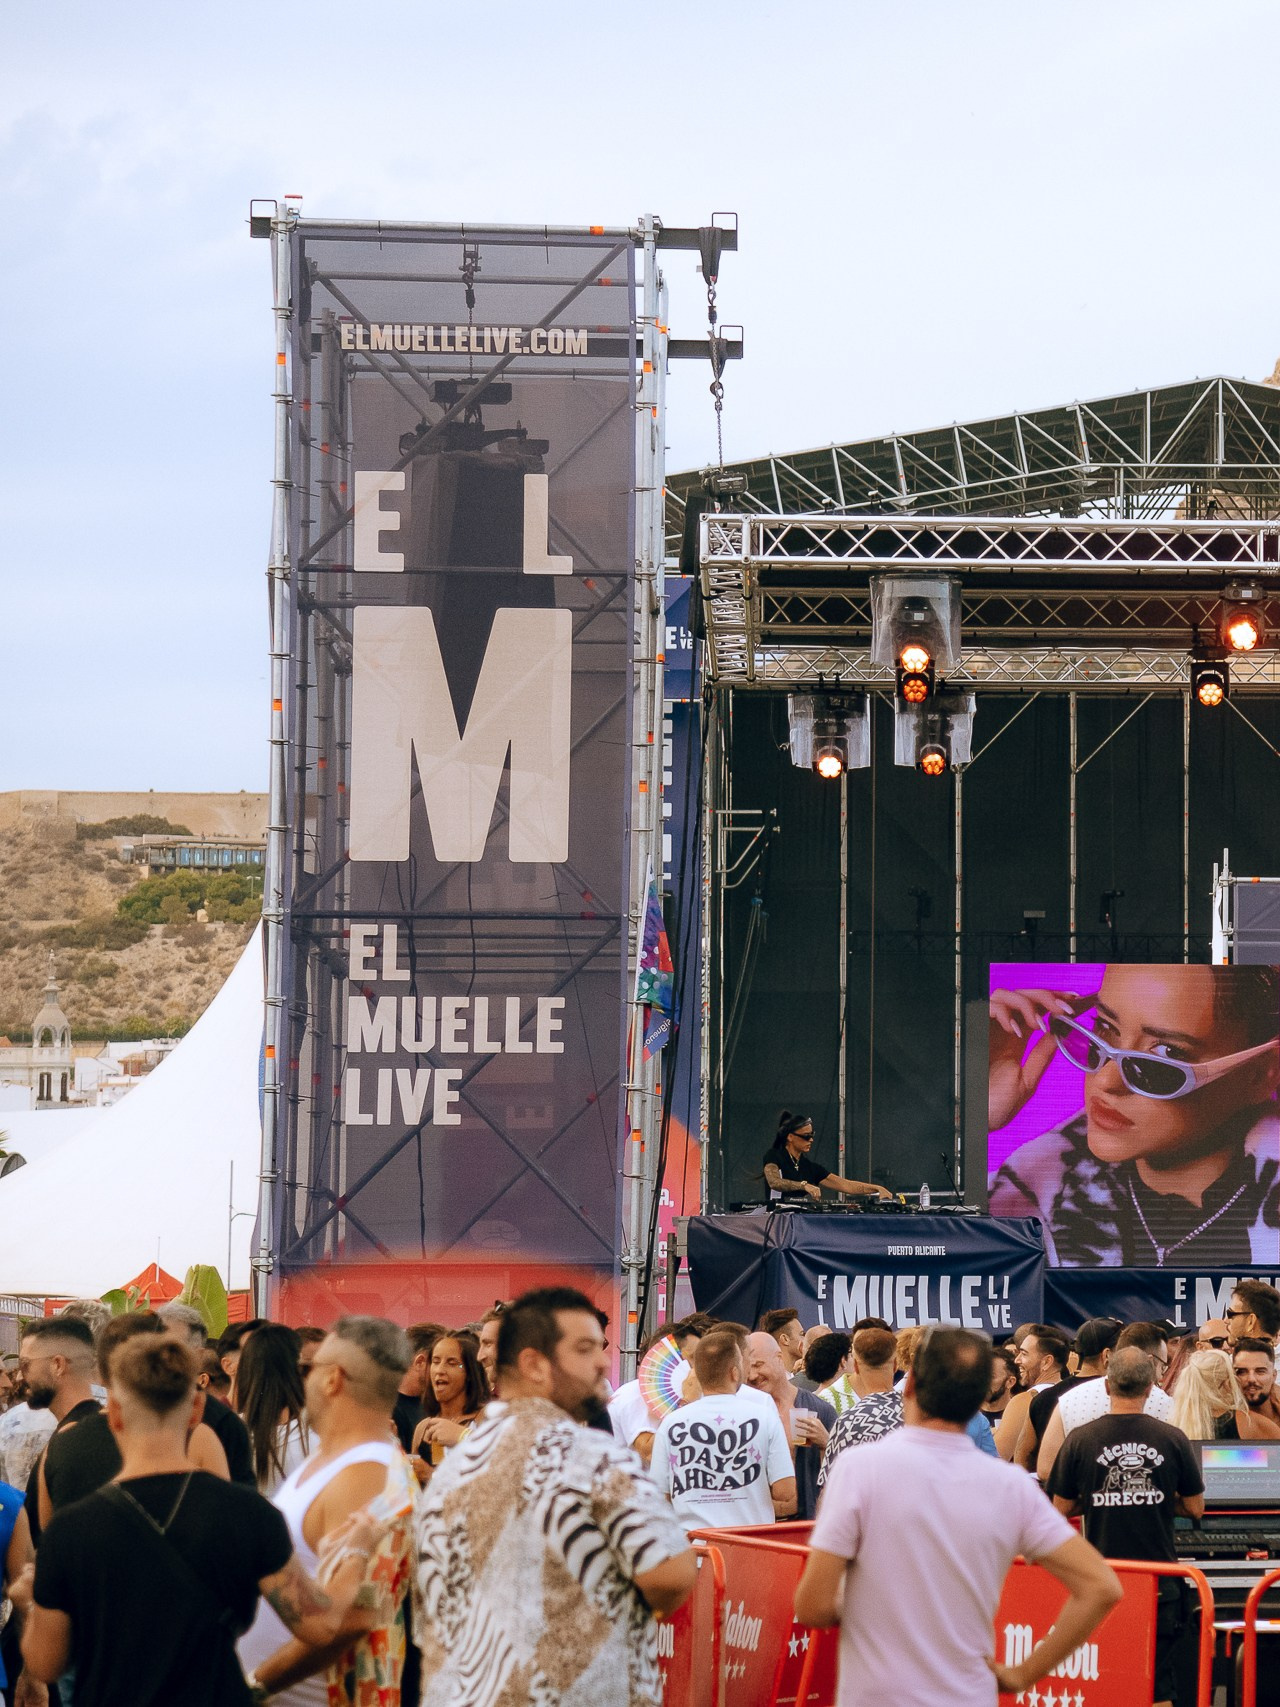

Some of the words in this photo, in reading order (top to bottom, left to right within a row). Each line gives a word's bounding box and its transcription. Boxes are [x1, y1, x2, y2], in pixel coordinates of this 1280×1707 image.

[341, 323, 588, 355] ELMUELLELIVE.COM
[350, 606, 572, 862] M
[349, 924, 410, 981] EL
[347, 996, 565, 1054] MUELLE
[345, 1069, 462, 1126] LIVE
[887, 1245, 913, 1256] PUERTO
[914, 1245, 946, 1256] ALICANTE
[833, 1275, 983, 1328] MUELLE
[668, 1418, 760, 1455] GOOD
[679, 1446, 748, 1473] DAYS
[672, 1463, 761, 1499] AHEAD
[1092, 1490, 1165, 1507] DIRECTO
